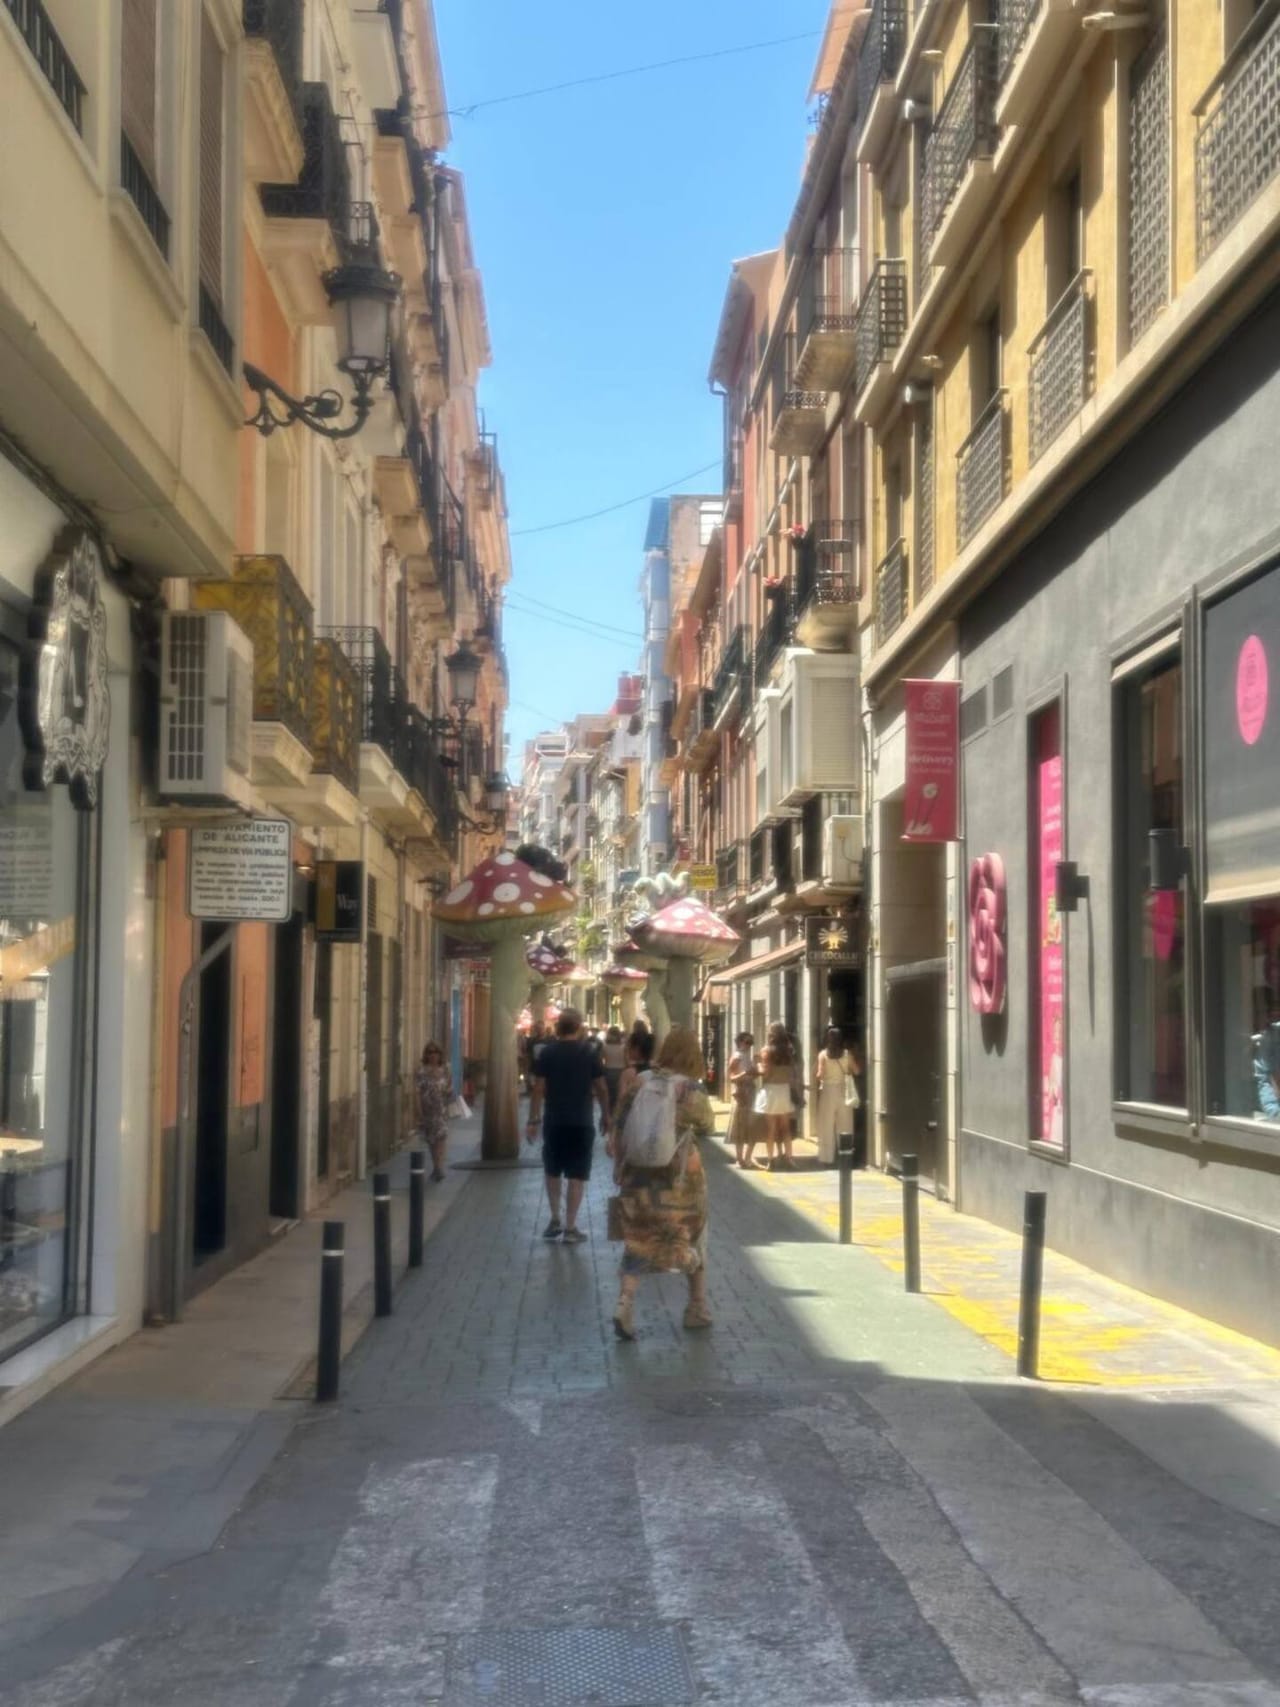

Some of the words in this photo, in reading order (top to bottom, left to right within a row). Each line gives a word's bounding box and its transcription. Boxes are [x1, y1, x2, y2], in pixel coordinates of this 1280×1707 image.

[216, 822, 285, 834] NTAMIENTO
[202, 832, 216, 841] DE
[224, 832, 279, 843] ALICANTE
